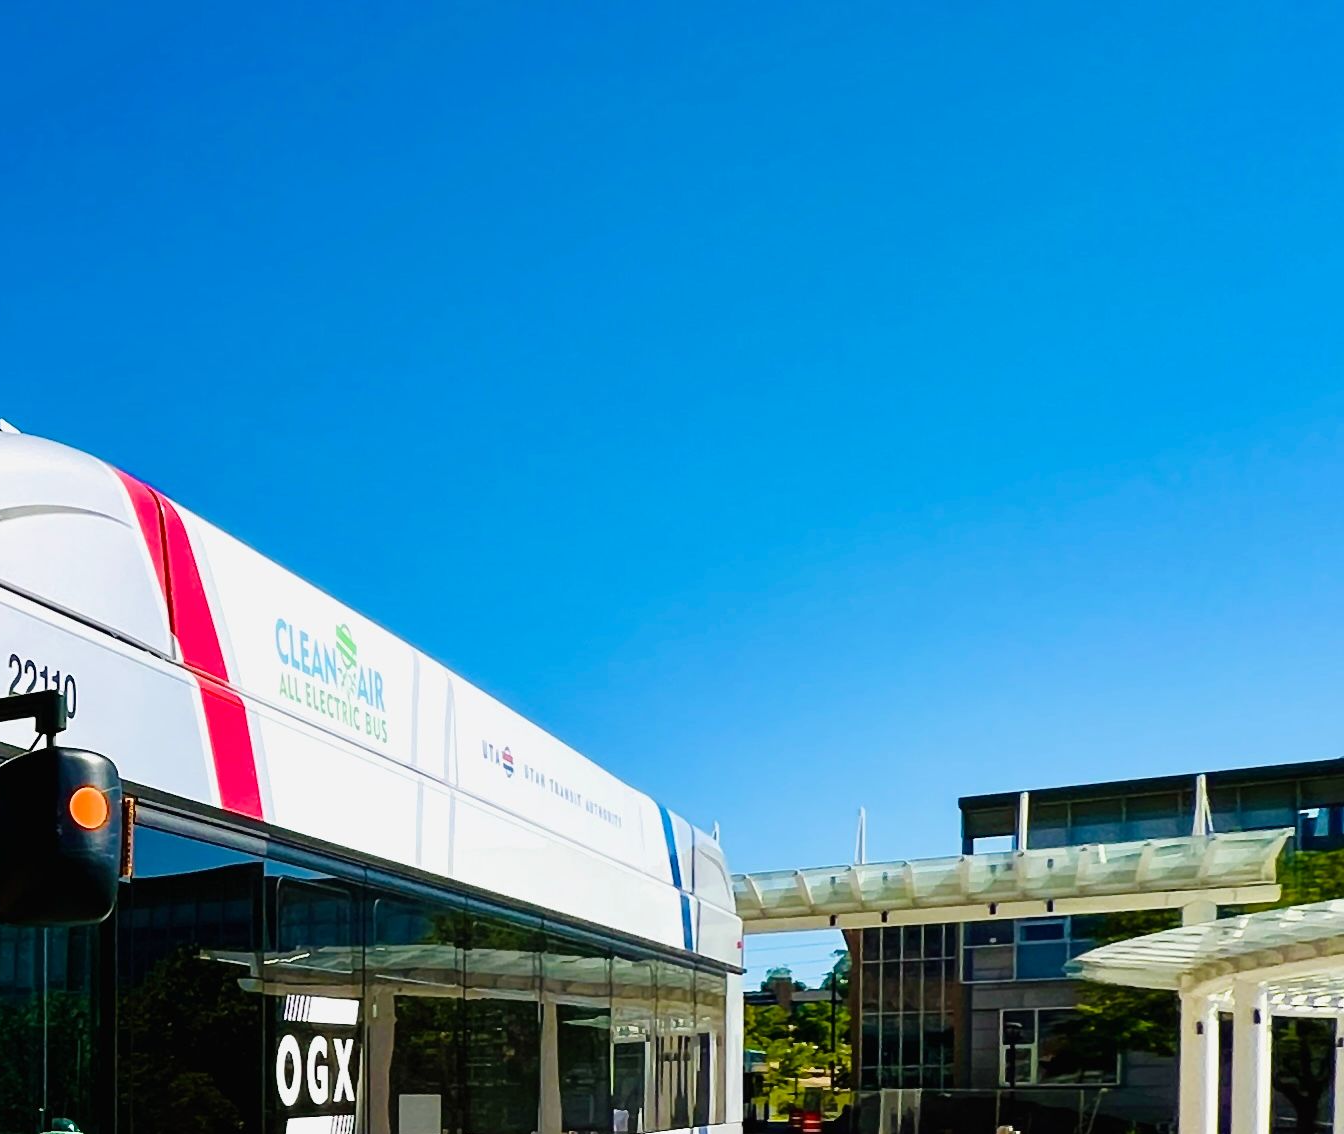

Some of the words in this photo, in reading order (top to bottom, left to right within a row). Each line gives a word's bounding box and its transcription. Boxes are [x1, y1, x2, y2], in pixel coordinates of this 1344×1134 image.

[275, 618, 337, 687] CLEAN
[357, 664, 385, 713] AIR
[280, 672, 301, 703] ALL
[305, 682, 360, 731] ELECTRIC
[365, 711, 387, 743] BUS
[276, 1034, 355, 1106] OGX
